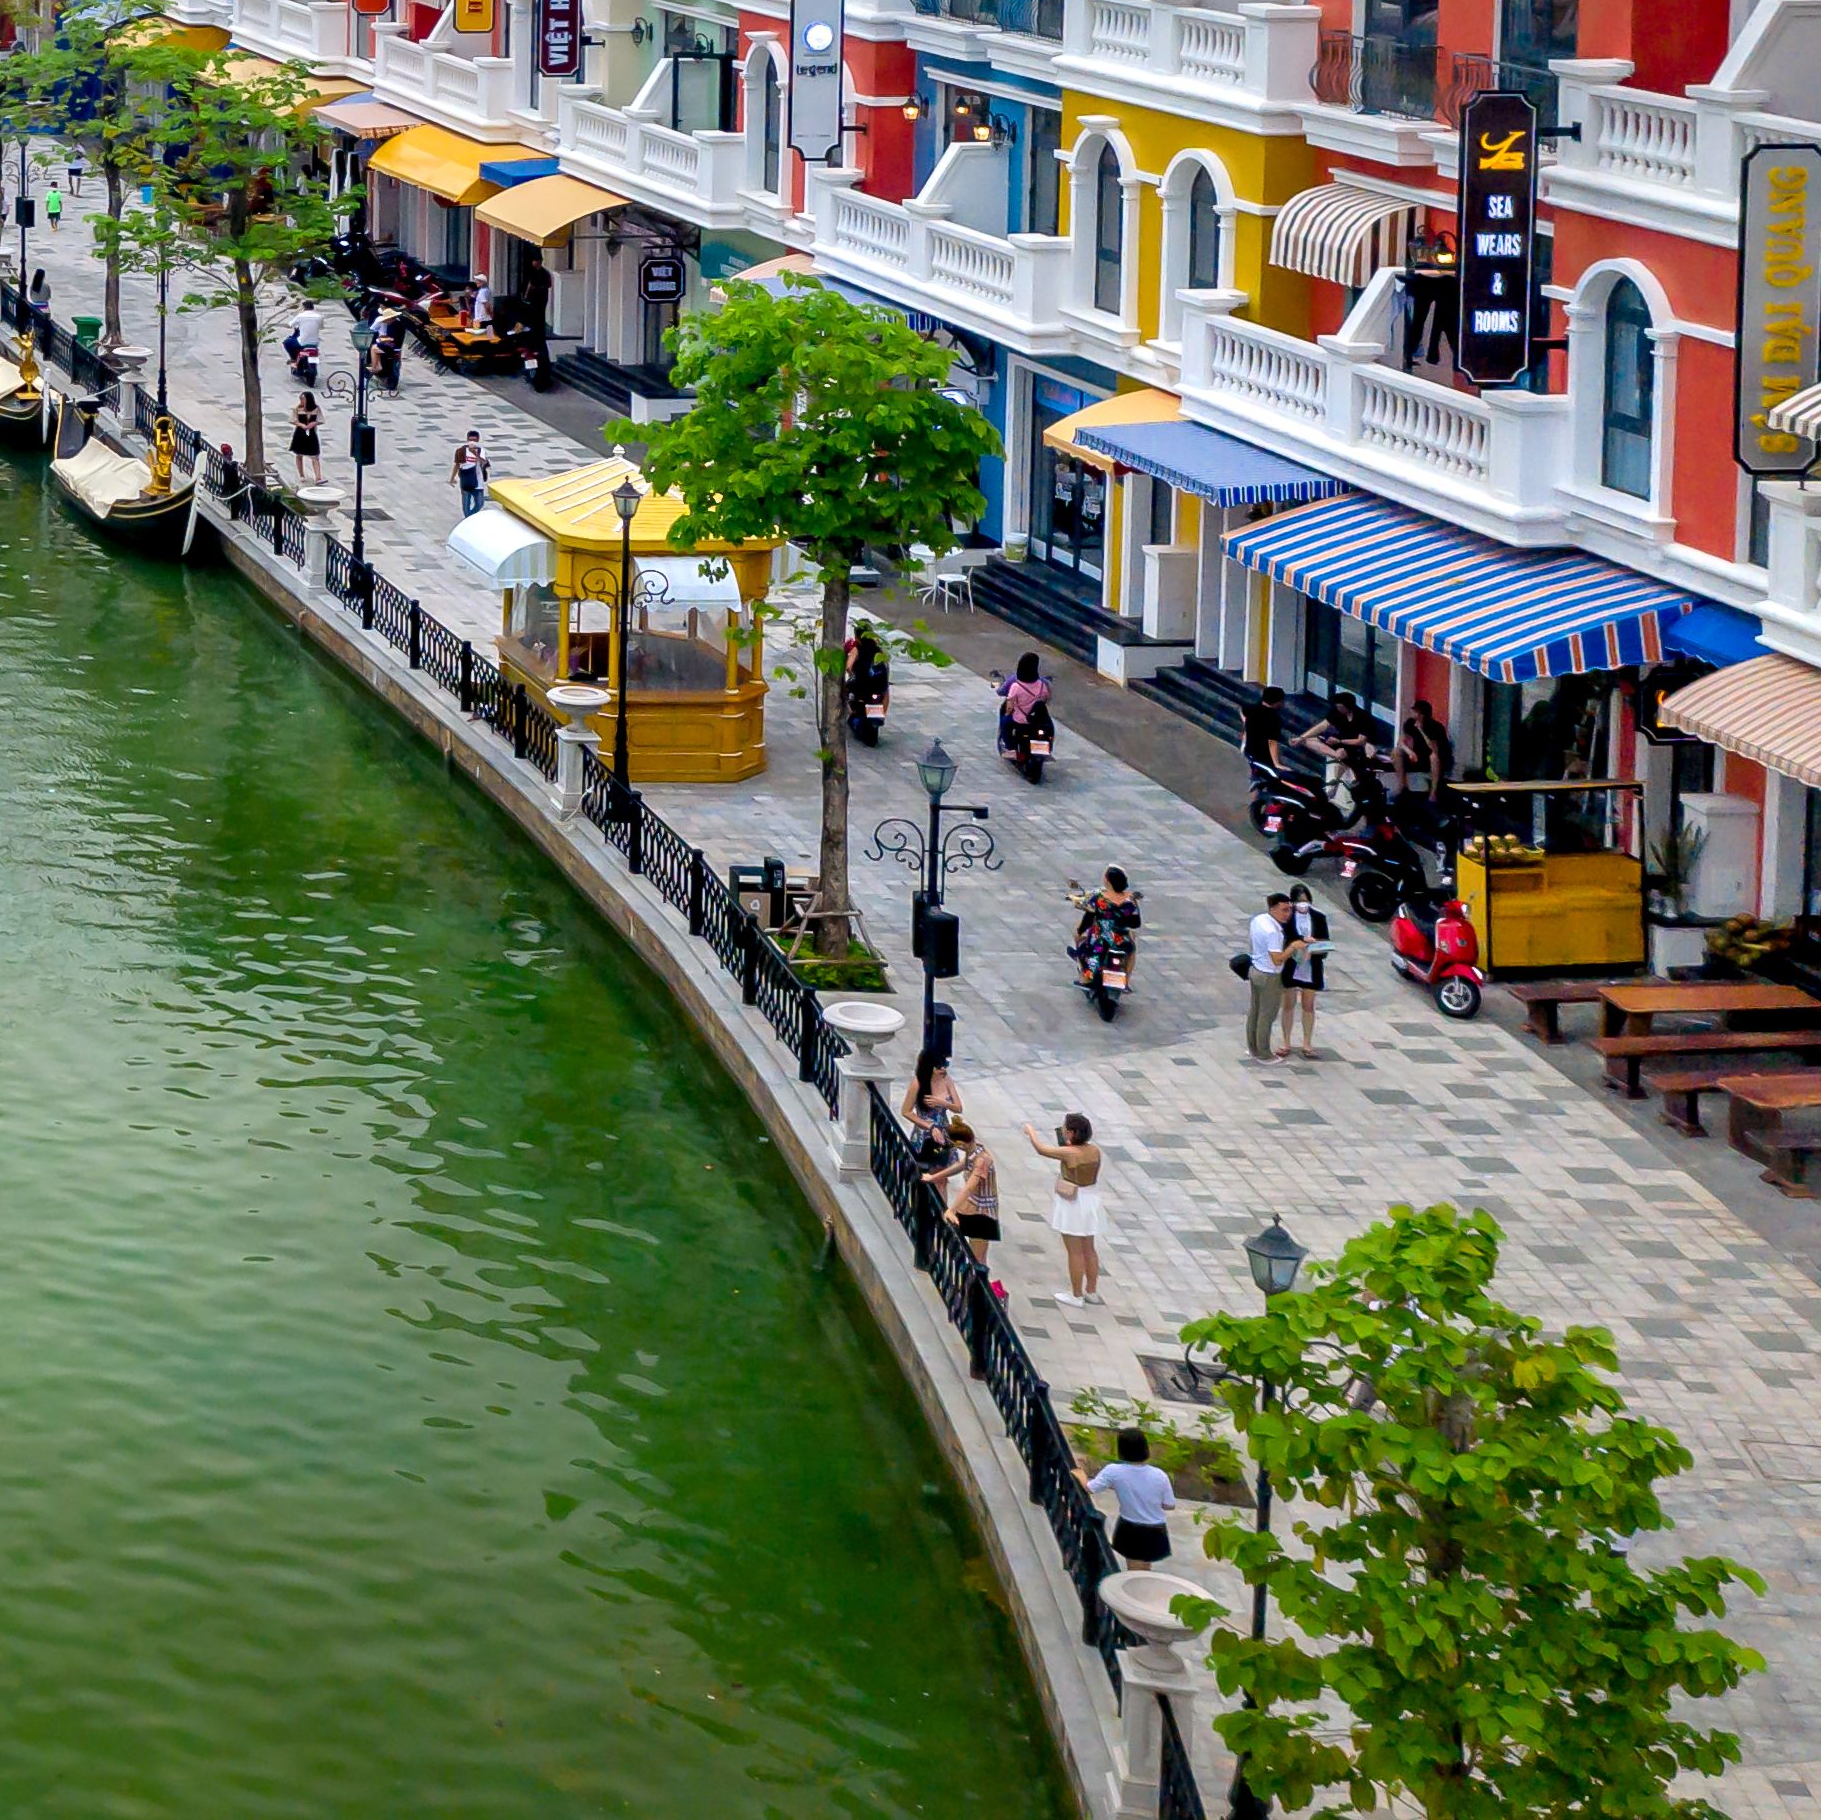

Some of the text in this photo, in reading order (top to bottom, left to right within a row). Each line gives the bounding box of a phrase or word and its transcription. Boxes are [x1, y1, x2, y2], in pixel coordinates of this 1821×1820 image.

[545, 17, 573, 67] VIỆT
[1487, 194, 1515, 220] SEA
[1764, 165, 1814, 289] QUANG
[1475, 232, 1522, 258] WEARS
[1492, 271, 1504, 296] &
[1473, 309, 1520, 334] ROOMS
